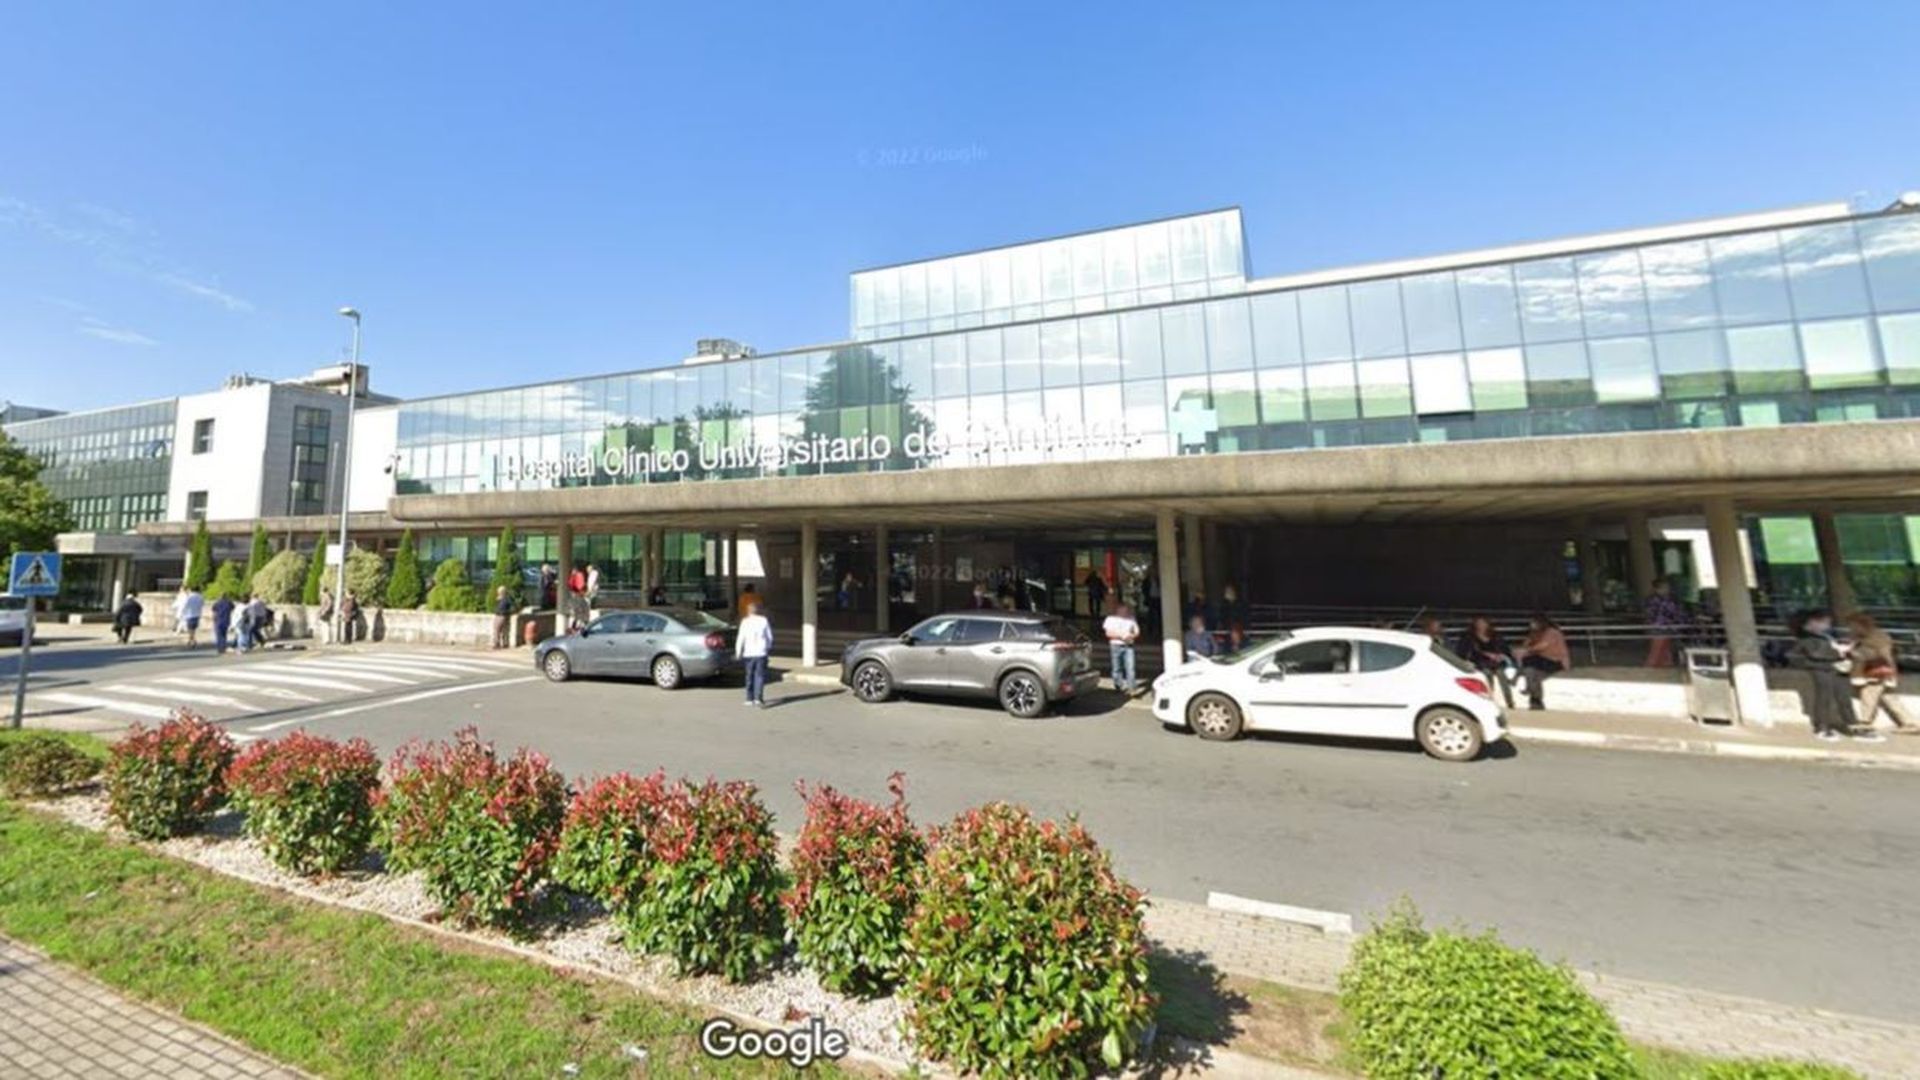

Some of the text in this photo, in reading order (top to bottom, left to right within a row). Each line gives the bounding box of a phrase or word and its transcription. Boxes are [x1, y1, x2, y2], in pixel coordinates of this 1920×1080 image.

[507, 453, 596, 480] Hospital
[603, 445, 690, 476] Clínico
[699, 434, 892, 470] Universitario
[904, 423, 949, 456] de
